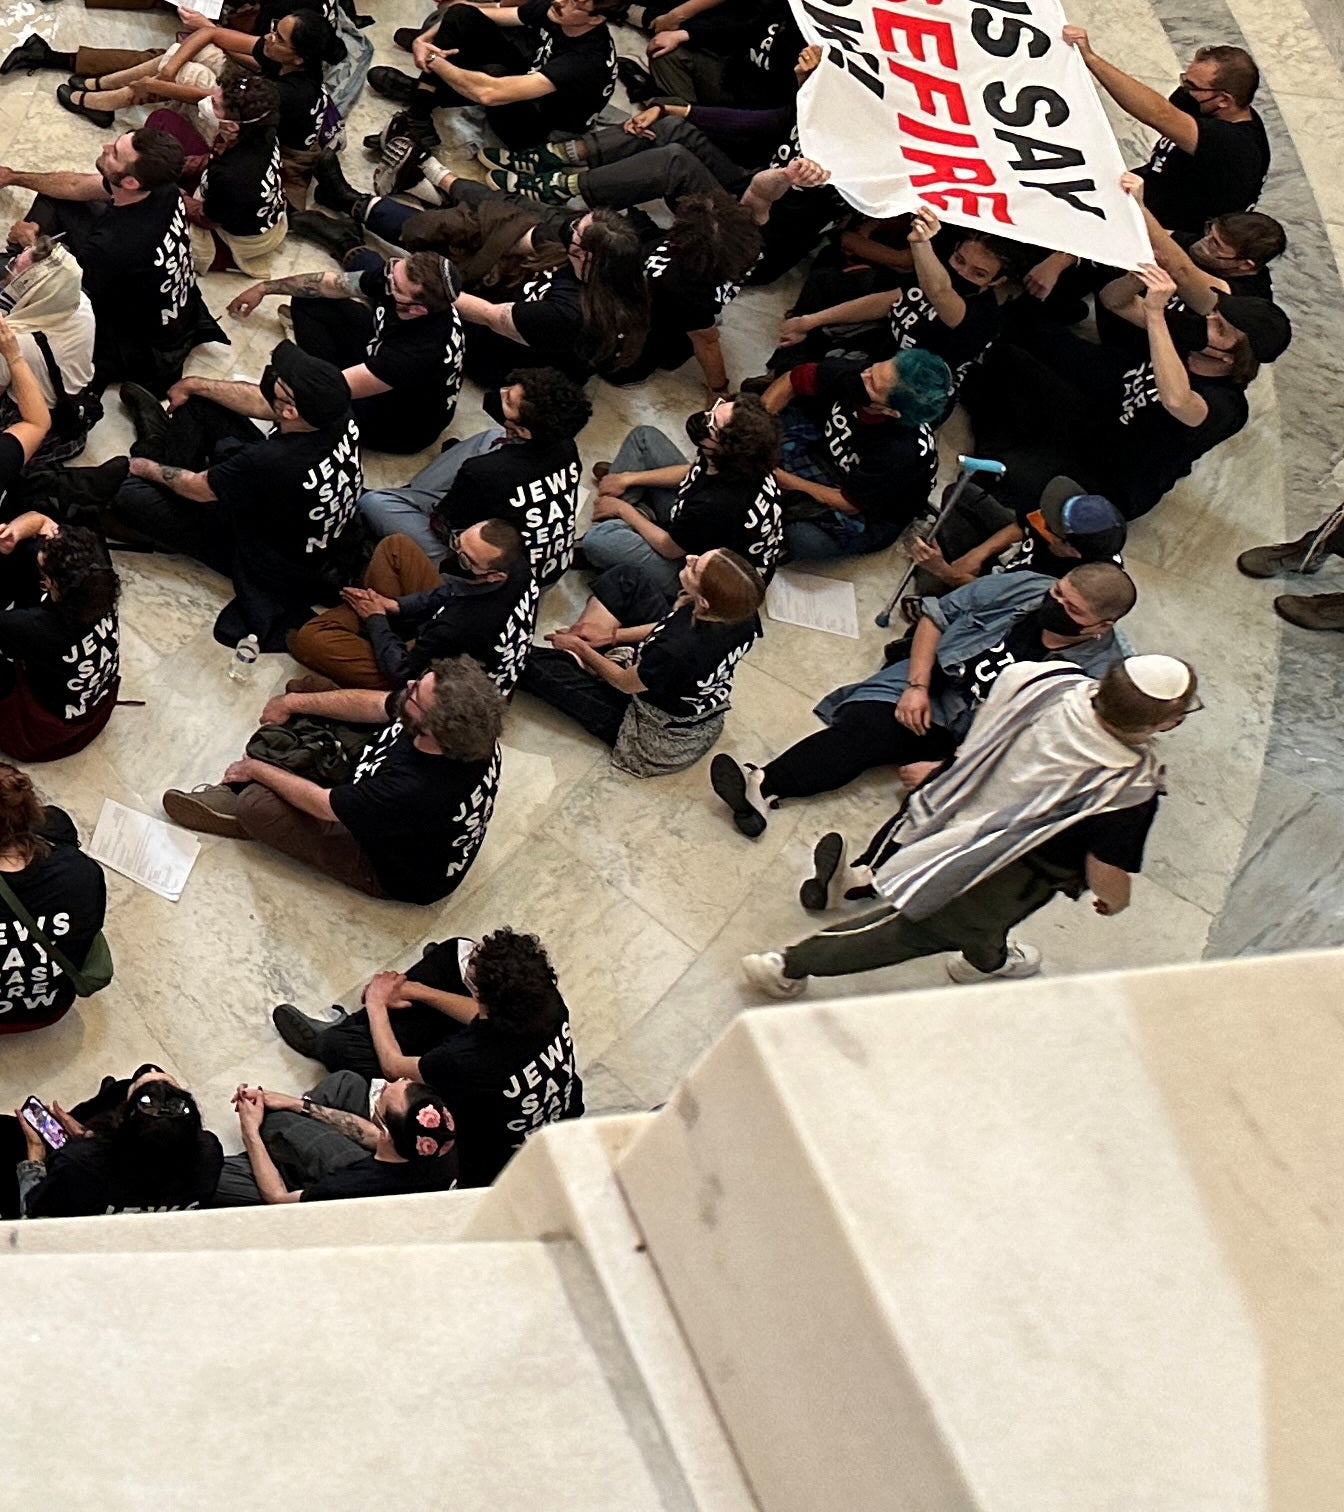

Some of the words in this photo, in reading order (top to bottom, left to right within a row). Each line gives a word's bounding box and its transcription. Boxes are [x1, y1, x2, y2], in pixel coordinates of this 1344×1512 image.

[982, 79, 1108, 221] SAY
[302, 418, 361, 489] JEWS
[510, 461, 581, 508] JEWS
[526, 495, 578, 530] SAY
